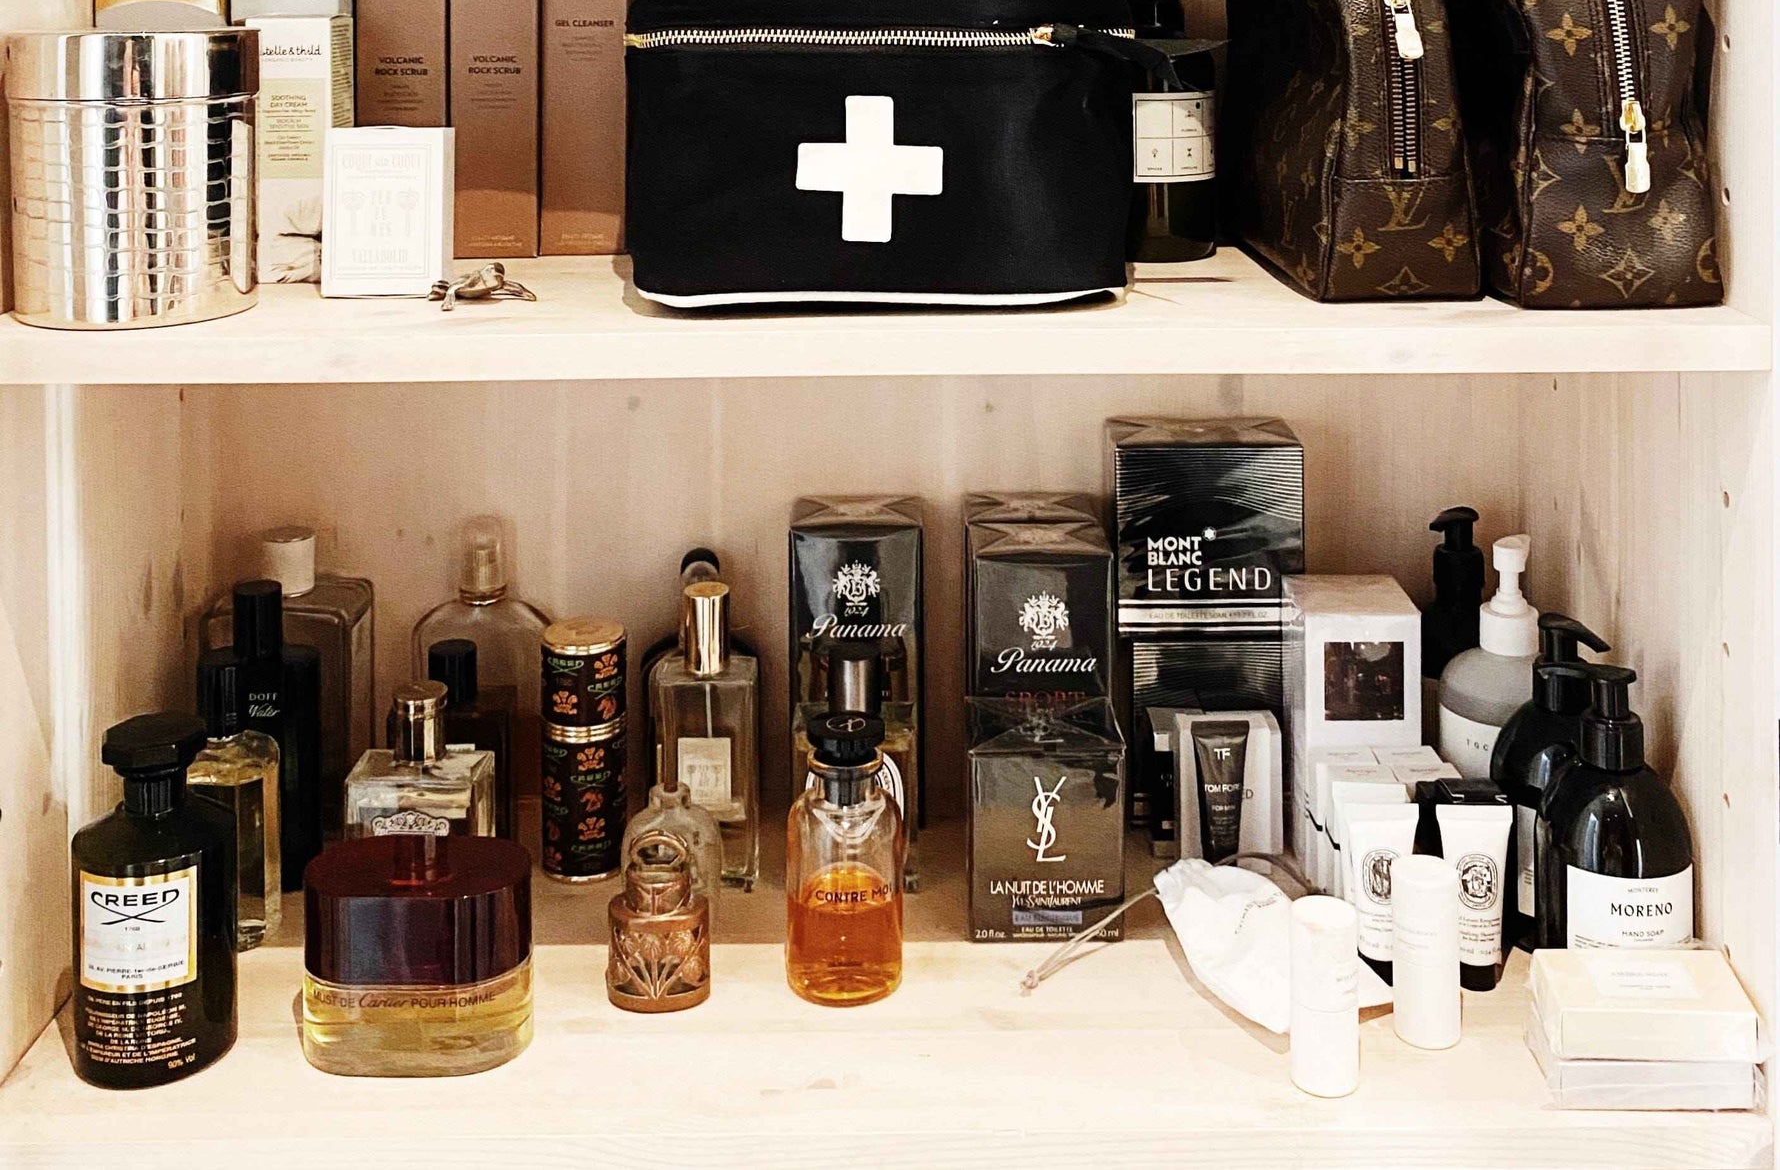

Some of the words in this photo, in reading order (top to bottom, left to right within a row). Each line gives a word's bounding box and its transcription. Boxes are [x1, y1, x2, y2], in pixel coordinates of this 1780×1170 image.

[1147, 536, 1202, 550] MONT
[1148, 551, 1202, 565] BLANC
[1148, 567, 1271, 591] LEGEND
[805, 613, 907, 638] Panama
[990, 647, 1097, 673] Panama
[1213, 748, 1231, 760] TF
[1205, 784, 1221, 792] TOM
[1026, 776, 1067, 862] YSL
[991, 880, 1005, 894] LA
[1005, 880, 1031, 894] NUIT
[1032, 880, 1046, 894] DE
[1049, 880, 1104, 894] L'HOMME
[815, 889, 867, 903] CONTRE
[91, 889, 180, 925] CREED
[1611, 902, 1673, 917] MORENO
[1109, 929, 1118, 937] ml
[1647, 929, 1664, 937] SOAP
[313, 990, 337, 1005] MUST
[340, 998, 355, 1008] DE
[359, 992, 408, 1009] Cartier
[411, 998, 447, 1008] POUR
[450, 992, 496, 1007] HOMME
